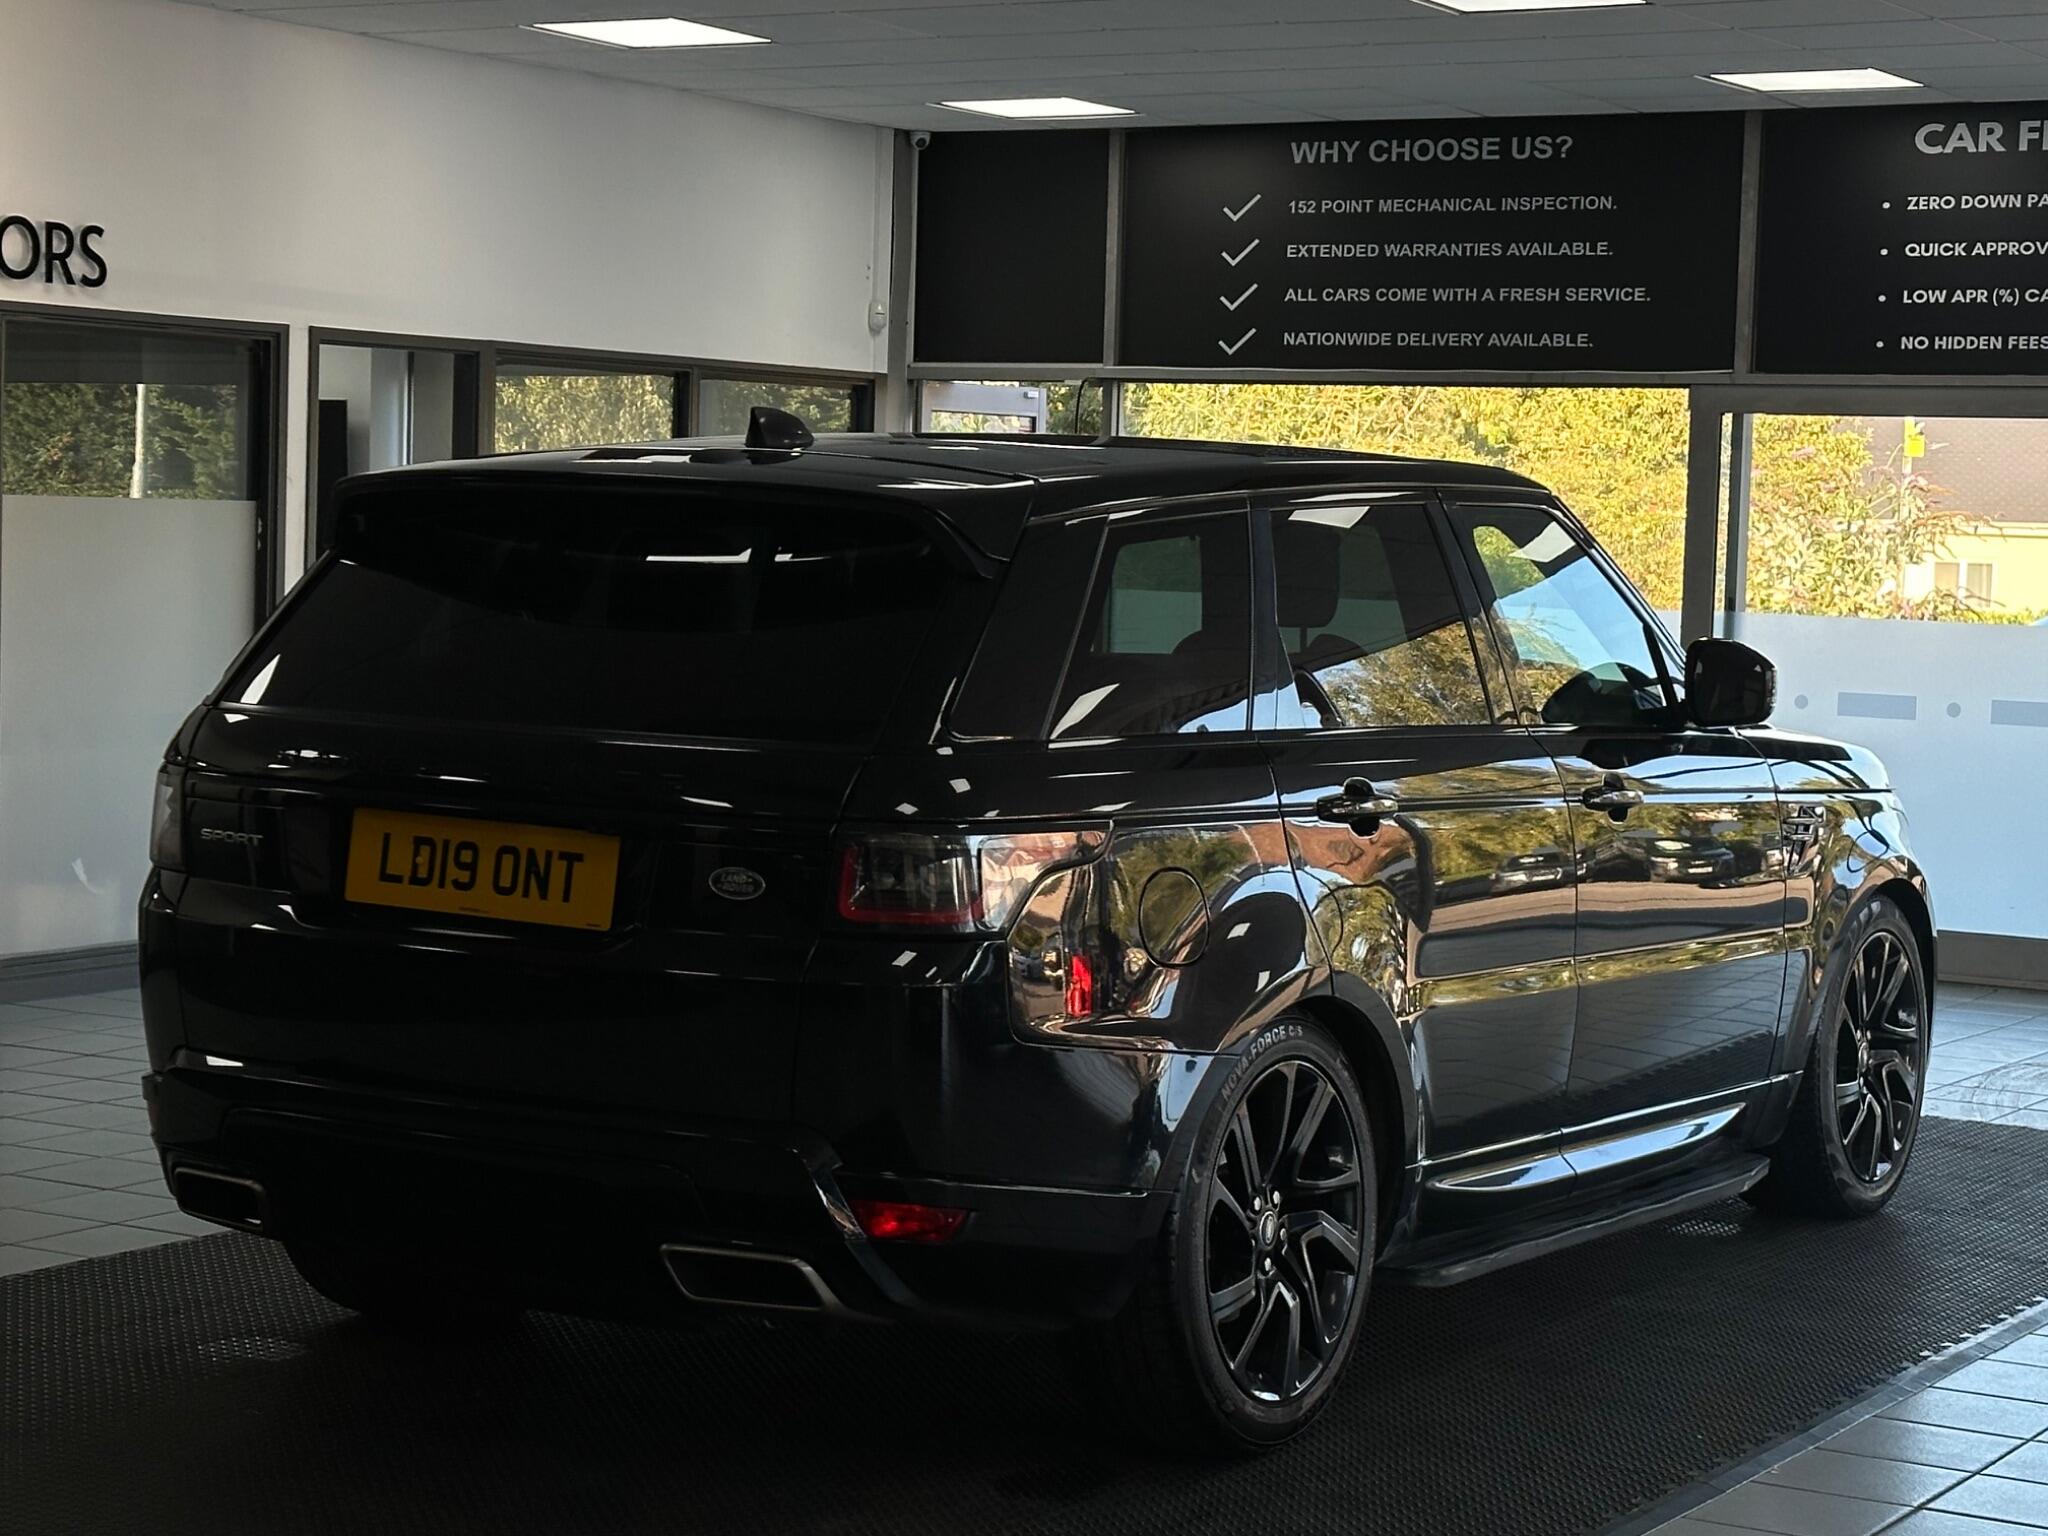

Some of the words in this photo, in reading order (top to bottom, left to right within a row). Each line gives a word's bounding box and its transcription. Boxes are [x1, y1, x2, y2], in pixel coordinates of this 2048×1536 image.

[1914, 121, 2007, 154] CAR
[1290, 140, 1361, 164] WHY
[1368, 137, 1501, 162] CHOOSE
[1511, 135, 1573, 160] US?
[1288, 200, 1317, 214] 152
[1321, 199, 1374, 213] POINT
[1378, 197, 1497, 213] MECHANICAL
[1501, 195, 1617, 211] INSPECTION.
[1906, 195, 1956, 211] ZERO
[1960, 193, 2022, 210] DOWN
[0, 214, 108, 288] ORS
[1286, 243, 1379, 258] EXTENDED
[1384, 242, 1502, 257] WARRANTIES
[1506, 241, 1614, 257] AVAILABLE.
[1904, 242, 1967, 258] QUICK
[1284, 288, 1318, 302] ALL
[1322, 288, 1371, 302] CARS
[1375, 288, 1428, 302] COME
[1432, 287, 1477, 302] WITH
[1481, 287, 1496, 302] A
[1500, 287, 1560, 302] FRESH
[1565, 287, 1651, 302] SERVICE.
[1902, 289, 1947, 304] LOW
[1951, 288, 1988, 303] APR
[1992, 287, 2019, 307] (%)
[1283, 332, 1392, 346] NATIONWIDE
[1397, 332, 1484, 347] DELIVERY
[1487, 333, 1594, 348] AVAILABLE.
[1901, 335, 1929, 350] NO
[1934, 335, 2002, 350] HIDDEN
[2007, 335, 2048, 350] FEES
[200, 827, 264, 847] SPORT
[378, 832, 480, 892] LD19
[492, 844, 585, 903] ONT
